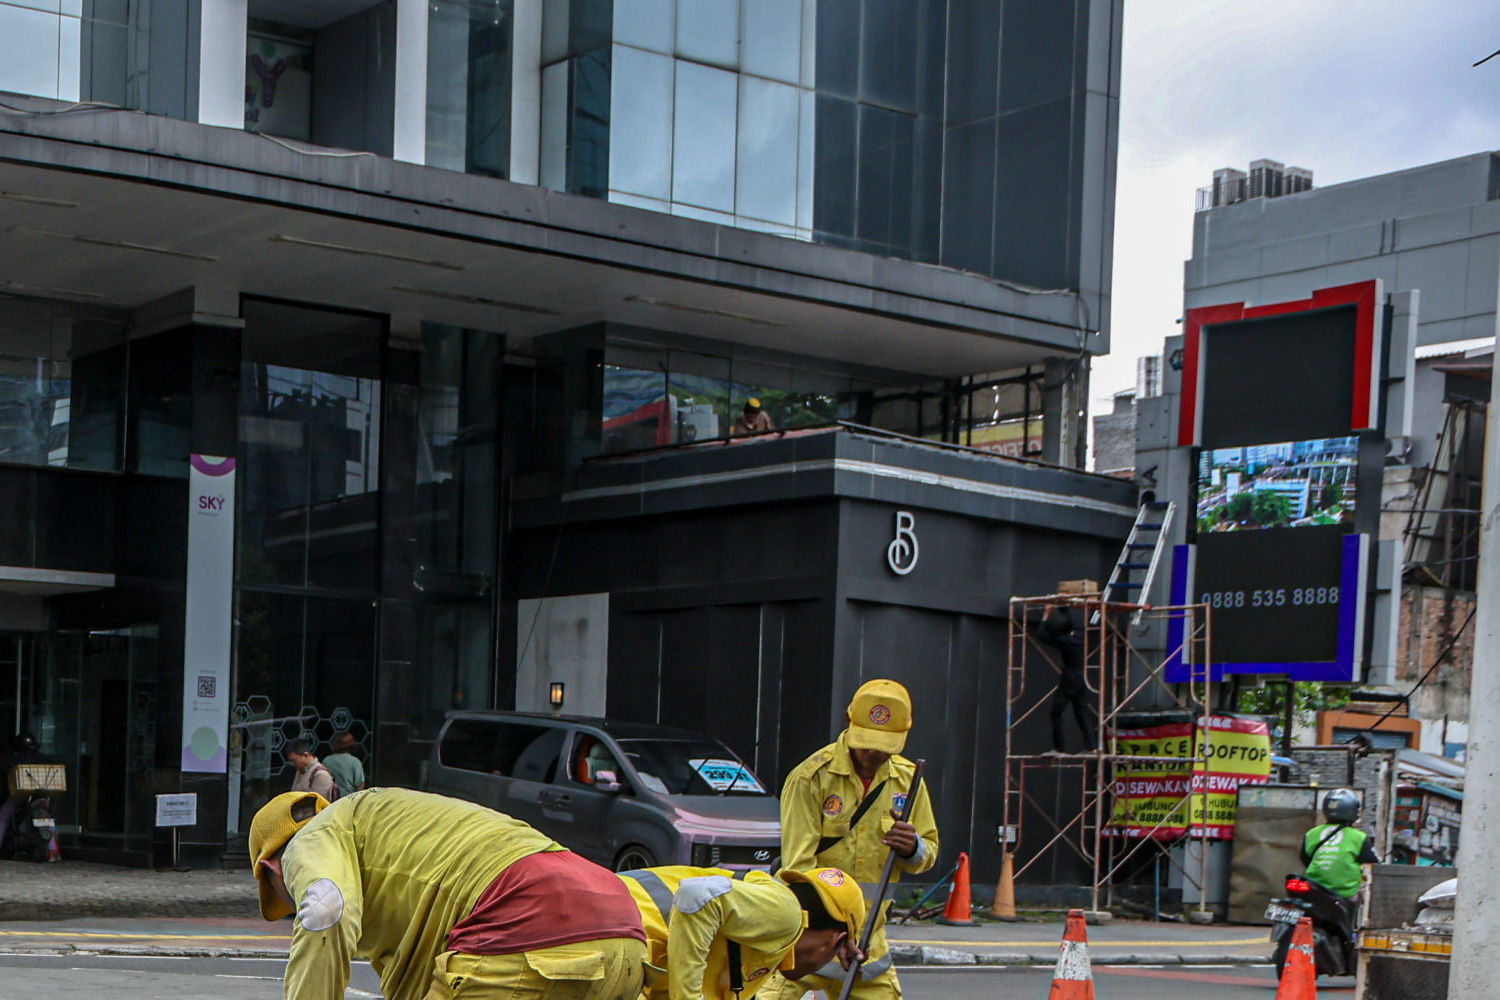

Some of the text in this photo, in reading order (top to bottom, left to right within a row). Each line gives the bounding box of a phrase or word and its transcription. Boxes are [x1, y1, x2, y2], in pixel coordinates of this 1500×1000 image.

[199, 495, 226, 511] SKY
[1252, 589, 1286, 607] 535
[1292, 587, 1339, 606] 8888
[1115, 740, 1188, 756] SPACE
[1198, 743, 1268, 762] ROOFTOP
[1115, 780, 1190, 795] DSEWAKAN
